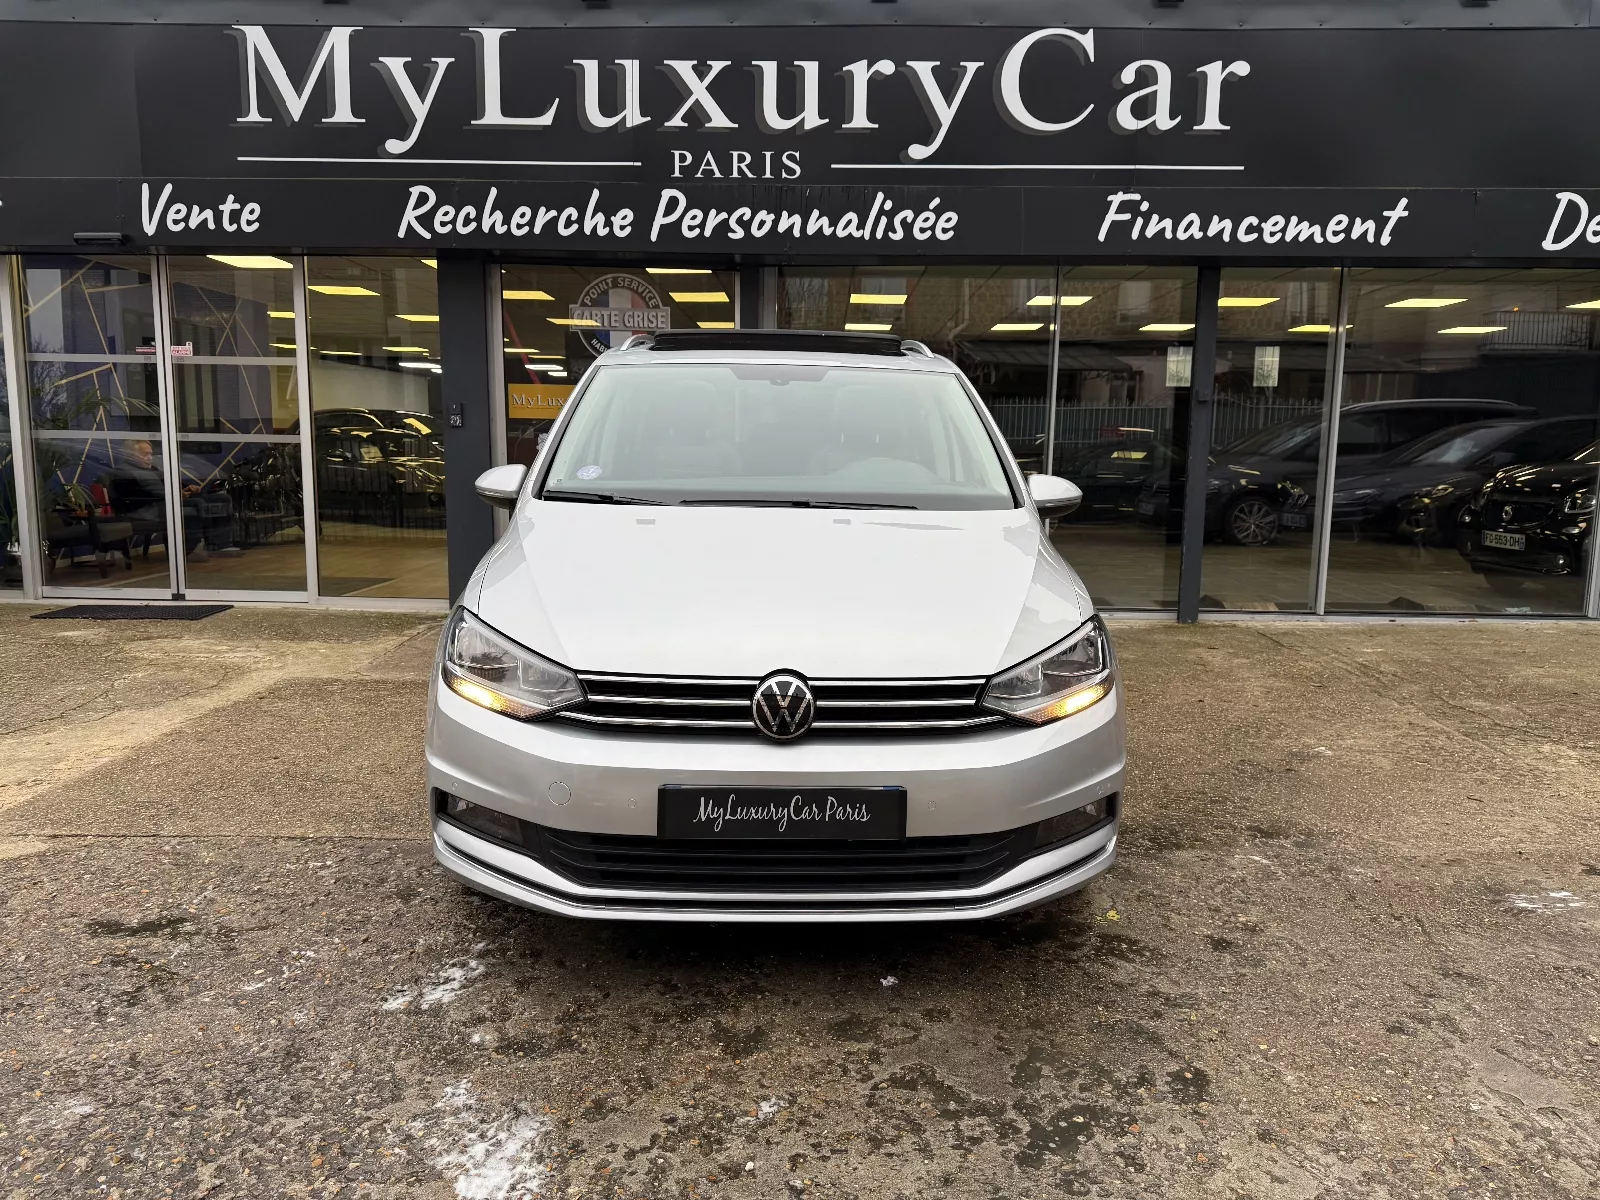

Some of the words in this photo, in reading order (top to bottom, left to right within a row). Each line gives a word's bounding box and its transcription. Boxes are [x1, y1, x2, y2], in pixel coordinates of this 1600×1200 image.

[231, 25, 1251, 160] MyLuxuryCar
[670, 150, 802, 179] PARIS
[141, 182, 261, 237] Vente
[397, 184, 634, 240] Recherche
[650, 188, 959, 243] Personnalisée
[1097, 191, 1409, 247] Financement
[584, 278, 613, 306] POINT
[617, 277, 659, 308] SERVICE
[573, 310, 619, 329] CARTE
[624, 311, 667, 329] GRISE
[511, 393, 567, 408] MyLux
[825, 795, 872, 822] Paris
